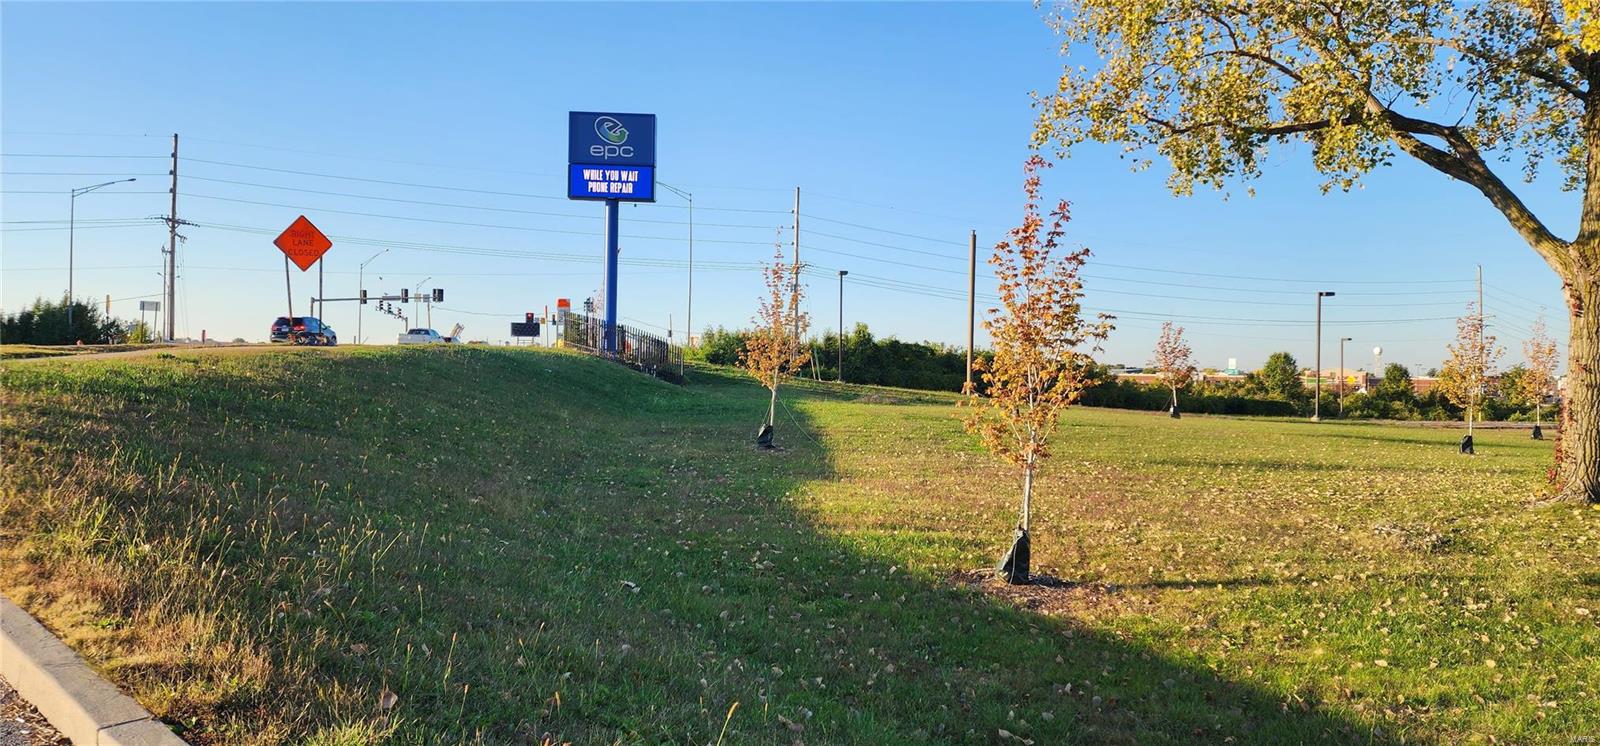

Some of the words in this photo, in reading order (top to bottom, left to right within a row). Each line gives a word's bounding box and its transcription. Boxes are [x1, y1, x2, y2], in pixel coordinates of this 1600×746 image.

[590, 145, 634, 160] epc
[583, 169, 604, 181] WHILE
[605, 170, 619, 181] YOU
[621, 171, 639, 182] WAIT
[588, 181, 609, 193] PHONE
[610, 183, 633, 194] REPAIR
[292, 239, 313, 247] LANE
[288, 249, 319, 257] CLOSED
